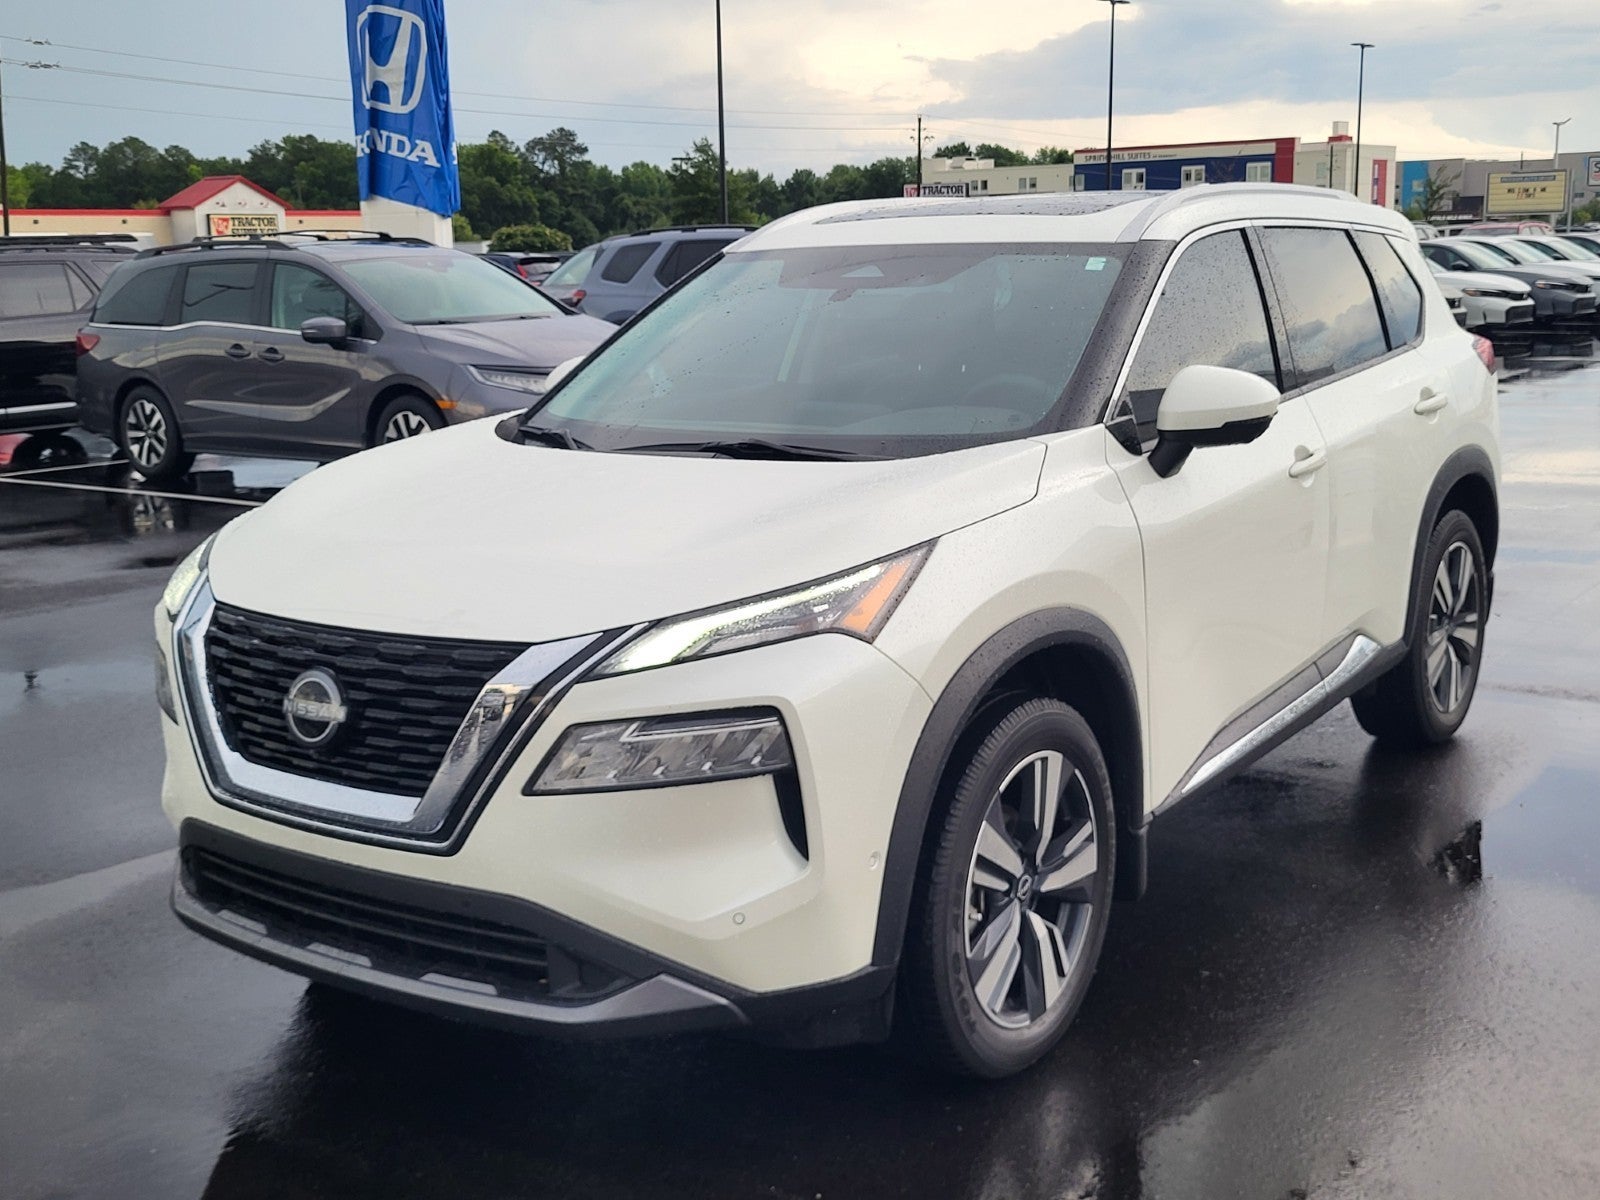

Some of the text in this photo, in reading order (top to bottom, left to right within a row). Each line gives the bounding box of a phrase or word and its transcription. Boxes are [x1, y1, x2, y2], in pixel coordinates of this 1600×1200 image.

[1127, 152, 1151, 160] SUITES
[922, 185, 964, 195] TRACTOR
[230, 217, 276, 227] TRACTOR
[283, 697, 347, 722] NISSAN
